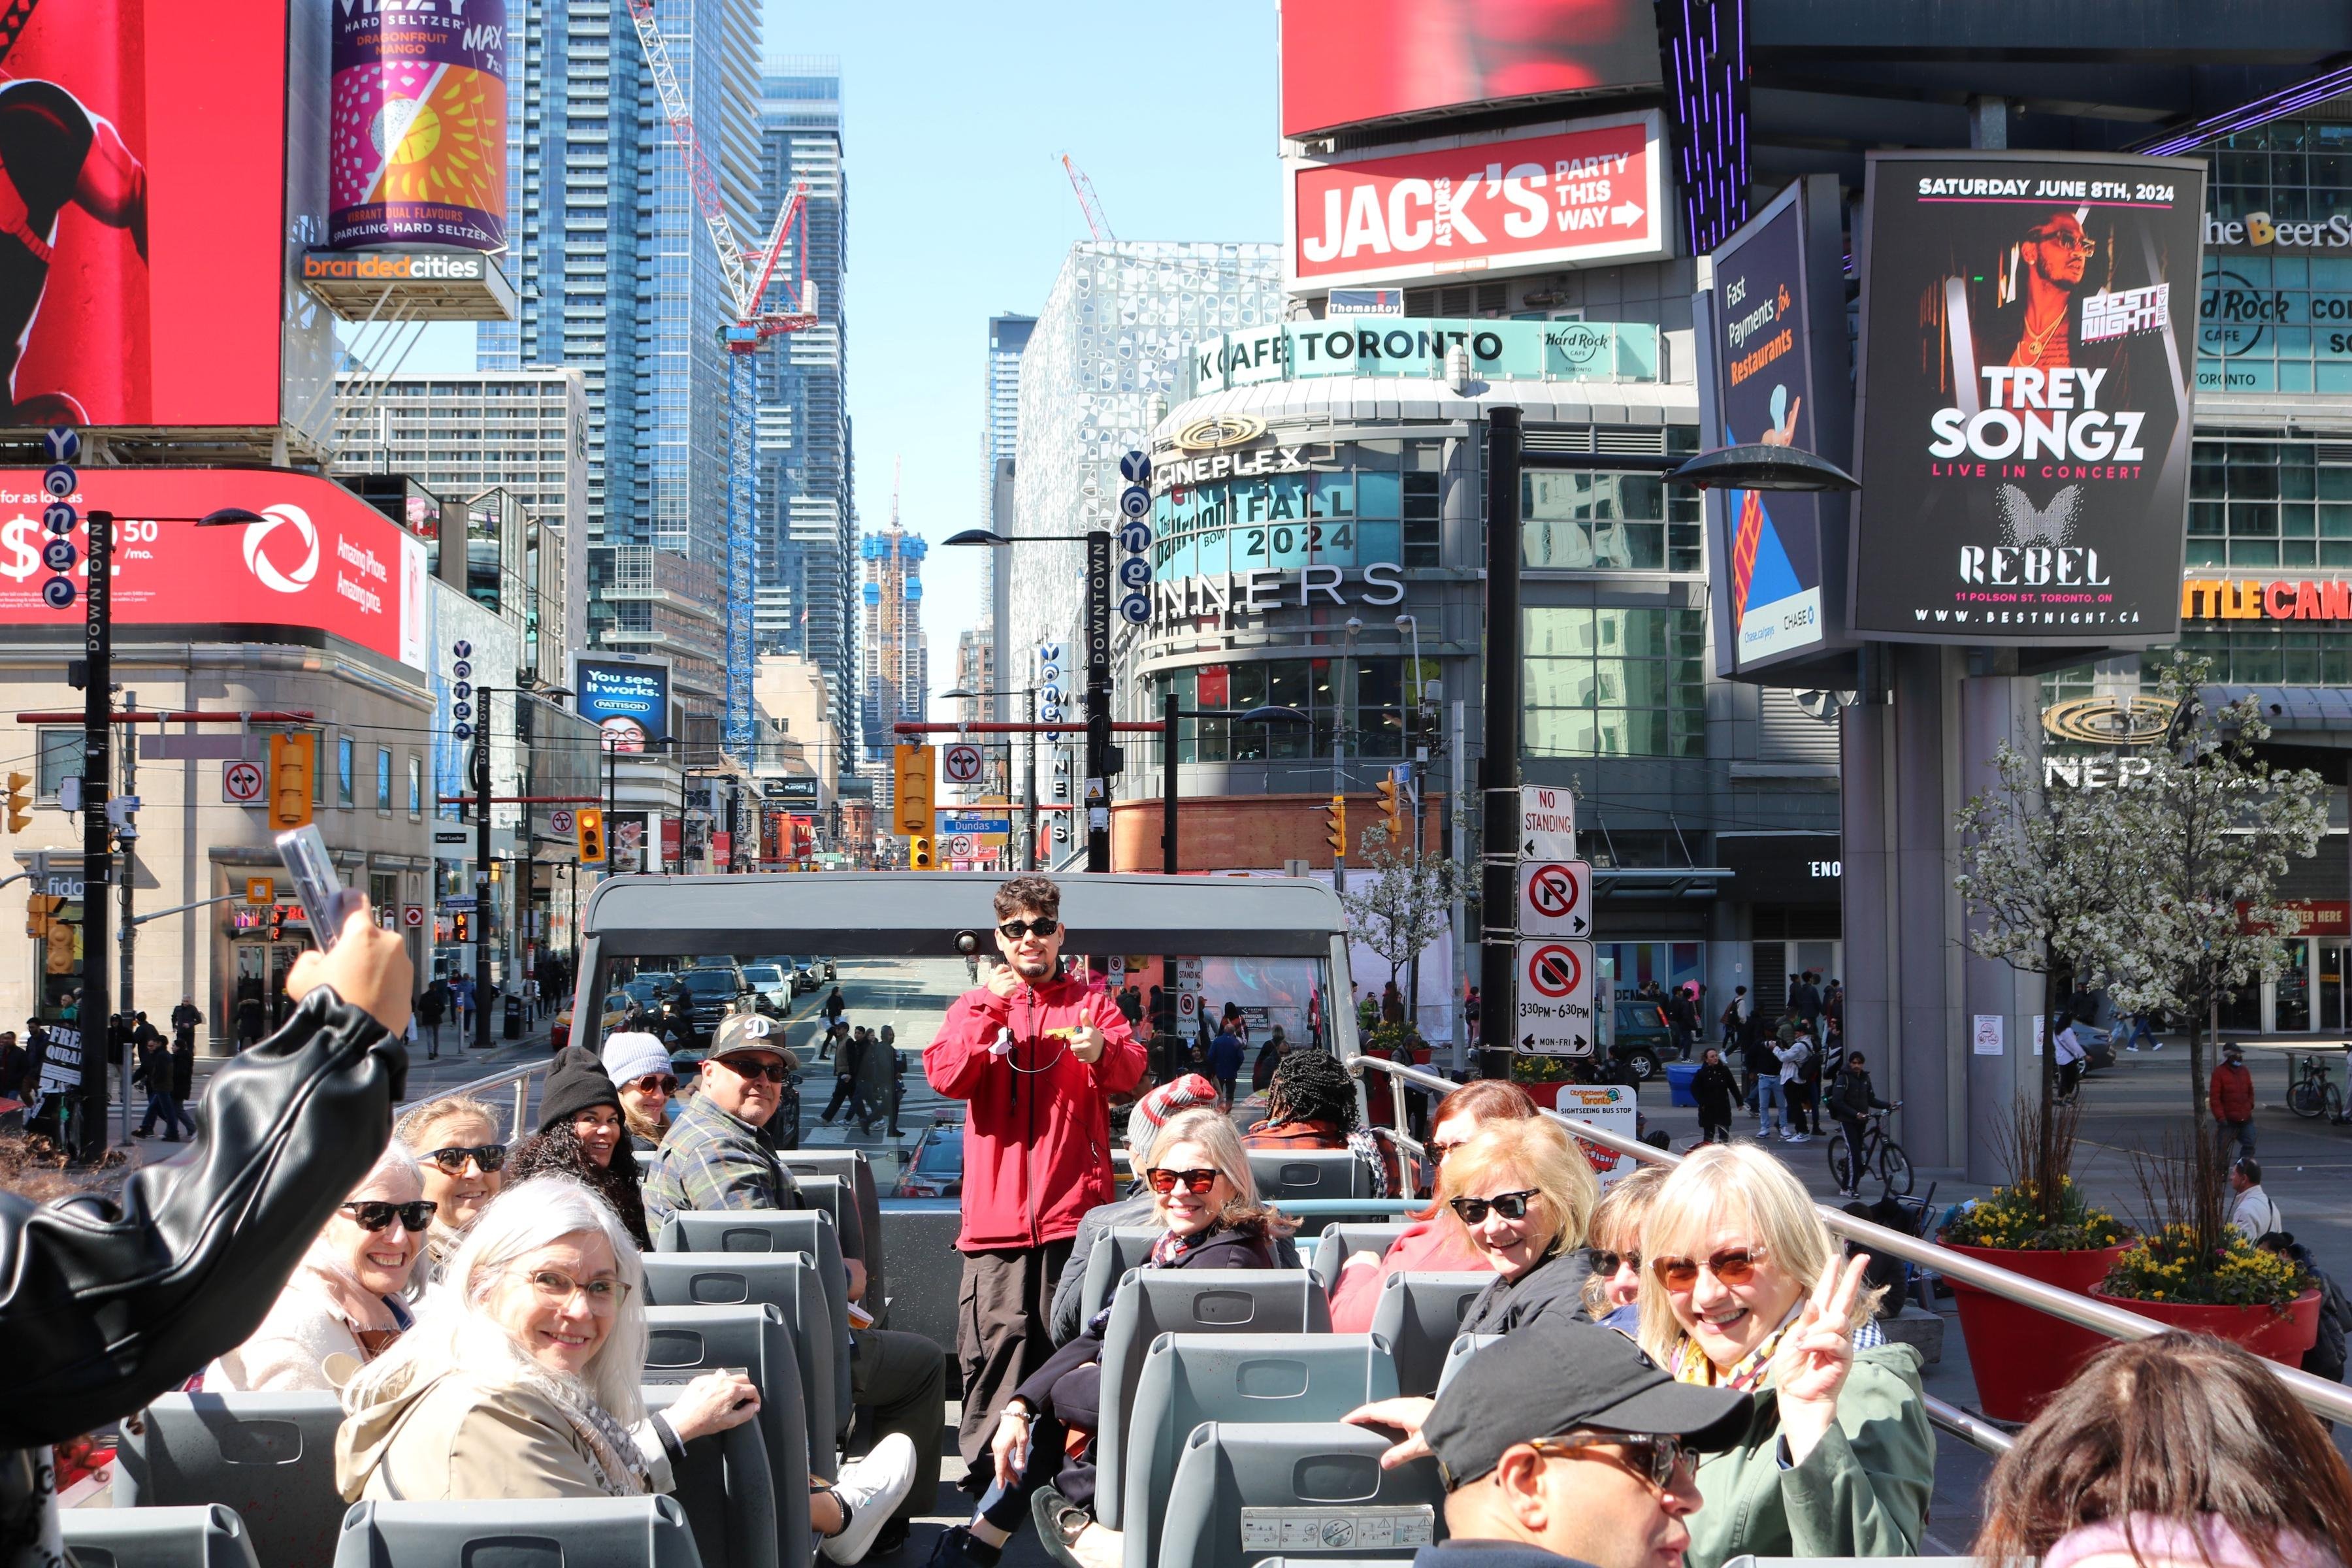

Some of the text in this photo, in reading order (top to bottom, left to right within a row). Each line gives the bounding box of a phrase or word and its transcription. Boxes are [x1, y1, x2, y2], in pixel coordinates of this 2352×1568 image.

[345, 17, 379, 33] HARD
[357, 32, 448, 46] DRAGONFRUIT
[463, 24, 502, 51] MAX
[376, 44, 426, 56] MANGO
[1555, 152, 1629, 182] PARTY
[1556, 180, 1611, 207] THIS
[1918, 178, 2175, 202] SATURDAY JUNE 8TH, 2024
[347, 207, 463, 223] VIBRANT DUAL FLAVOURS
[1303, 162, 1549, 263] JACK'S
[1434, 177, 1452, 247] ASTORS
[1557, 206, 1608, 232] WAY
[333, 223, 389, 242] SPARKLING
[393, 222, 433, 233] HARD
[304, 255, 478, 278] brandedcities
[1727, 275, 1746, 310] Fast
[2082, 285, 2157, 319] BEST
[1331, 302, 1399, 315] ThomasRoy
[1729, 283, 1791, 349] Payments for
[2157, 286, 2167, 324] EVER
[2223, 289, 2289, 323] Rock
[2081, 306, 2157, 340] NIGHT
[1545, 333, 1607, 349] Hard Rock
[2205, 330, 2240, 342] CAFE
[1201, 329, 1503, 382] K CAFE TORONTO
[1731, 328, 1793, 387] Restaurants
[1981, 365, 2108, 410] TREY
[1927, 408, 2146, 461] SONGZ
[1157, 447, 1303, 487] CINEPLEX
[1932, 463, 2142, 480] LIVE IN CONCERT
[1, 491, 20, 503] for
[22, 495, 37, 503] as
[68, 495, 83, 503] as
[1247, 491, 1354, 522] FALL
[123, 520, 158, 542] 50
[1121, 451, 1151, 624] Yonge
[1247, 524, 1354, 556] 2024
[125, 548, 154, 559] /mo.
[337, 533, 366, 577] Amazing
[1959, 546, 2110, 586] REBEL
[89, 523, 103, 652] DOWNTOWN
[337, 570, 366, 613] Amazing
[1969, 593, 2017, 602] POLSON
[2021, 594, 2036, 603] ST,
[2097, 594, 2112, 602] ON
[1094, 544, 1105, 664] DOWNTOWN
[1784, 610, 1807, 630] CHASE
[587, 681, 660, 697] It works.
[588, 670, 659, 685] You see.
[598, 700, 646, 710] PATTISON
[1539, 791, 1555, 809] NO
[955, 821, 990, 830] Dundas
[1525, 813, 1571, 833] STANDING
[48, 877, 84, 896] fido
[2317, 910, 2342, 923] HERE
[1179, 971, 1201, 979] STANDING
[48, 1026, 82, 1049] FRE
[745, 1017, 770, 1039] D
